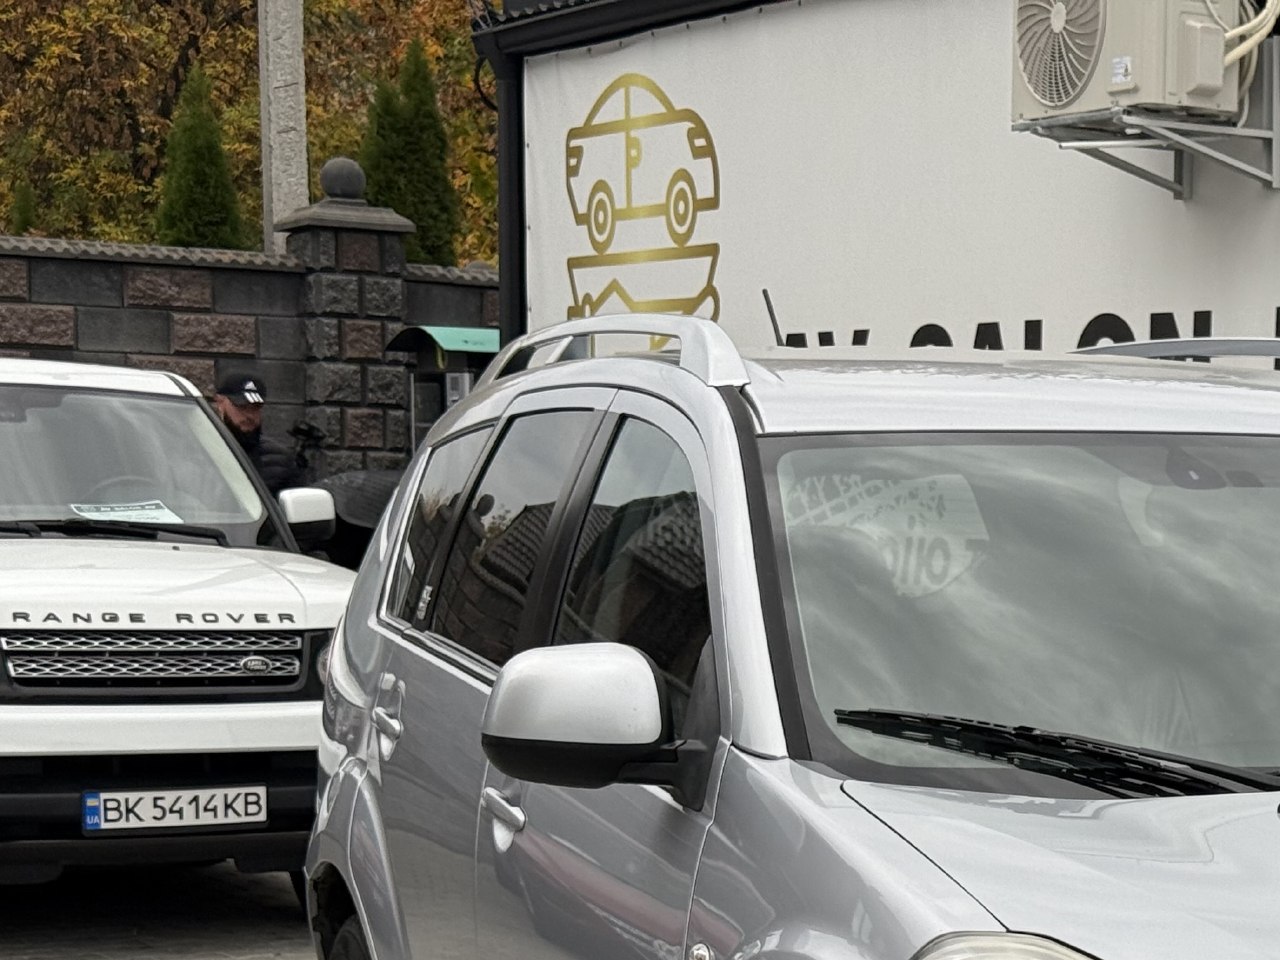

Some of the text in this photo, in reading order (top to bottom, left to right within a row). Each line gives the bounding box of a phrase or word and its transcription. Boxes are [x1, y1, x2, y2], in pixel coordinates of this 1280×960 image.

[12, 611, 296, 624] RANGE ROVER
[86, 815, 100, 825] UA
